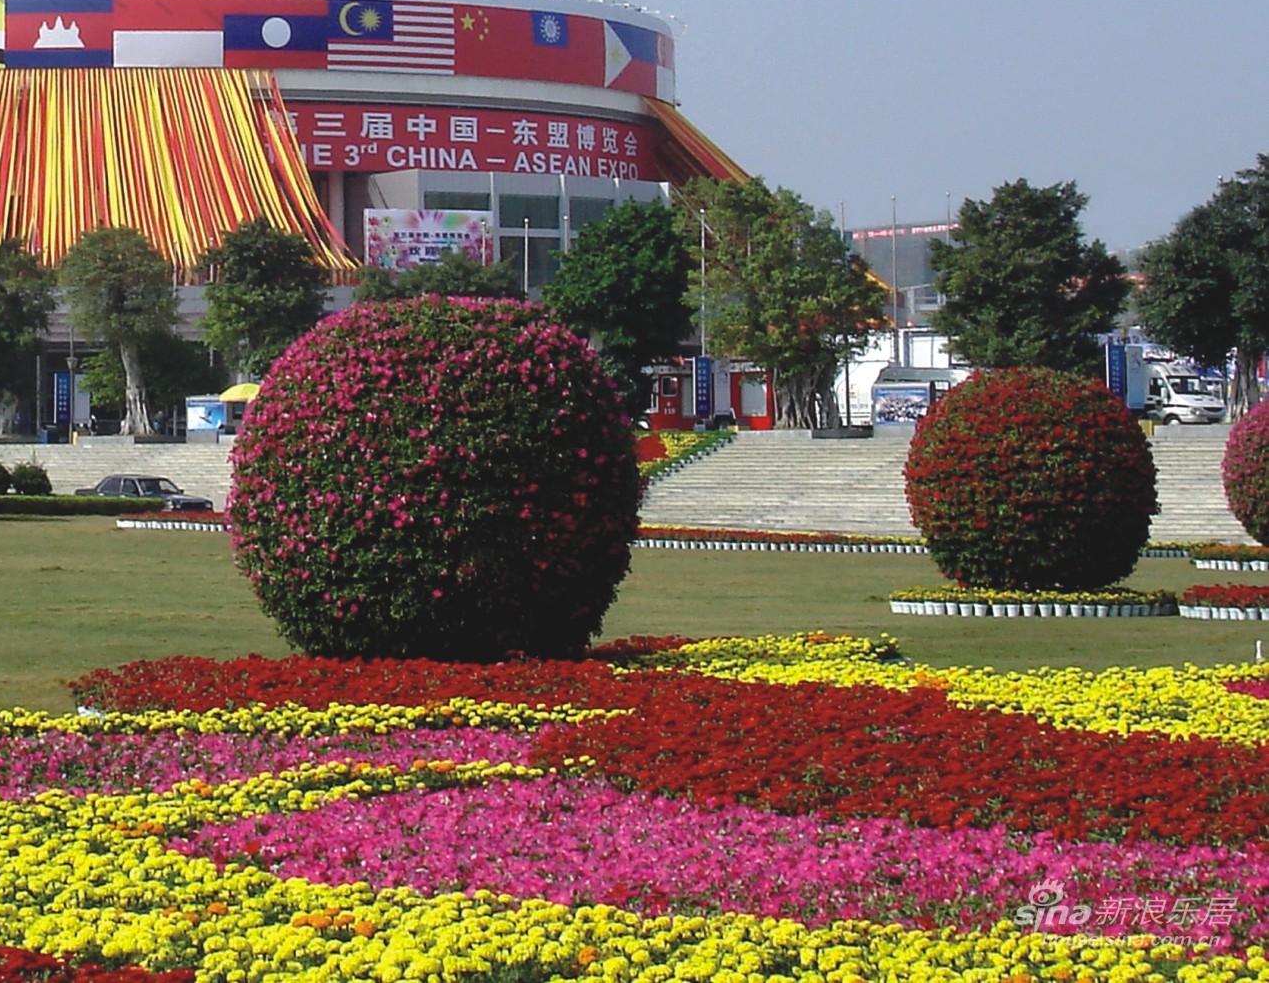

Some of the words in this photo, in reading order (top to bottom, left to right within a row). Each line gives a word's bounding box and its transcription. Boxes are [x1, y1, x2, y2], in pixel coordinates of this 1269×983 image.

[386, 145, 478, 169] CHINA
[513, 152, 590, 177] ASEAN
[597, 158, 638, 181] EXPO
